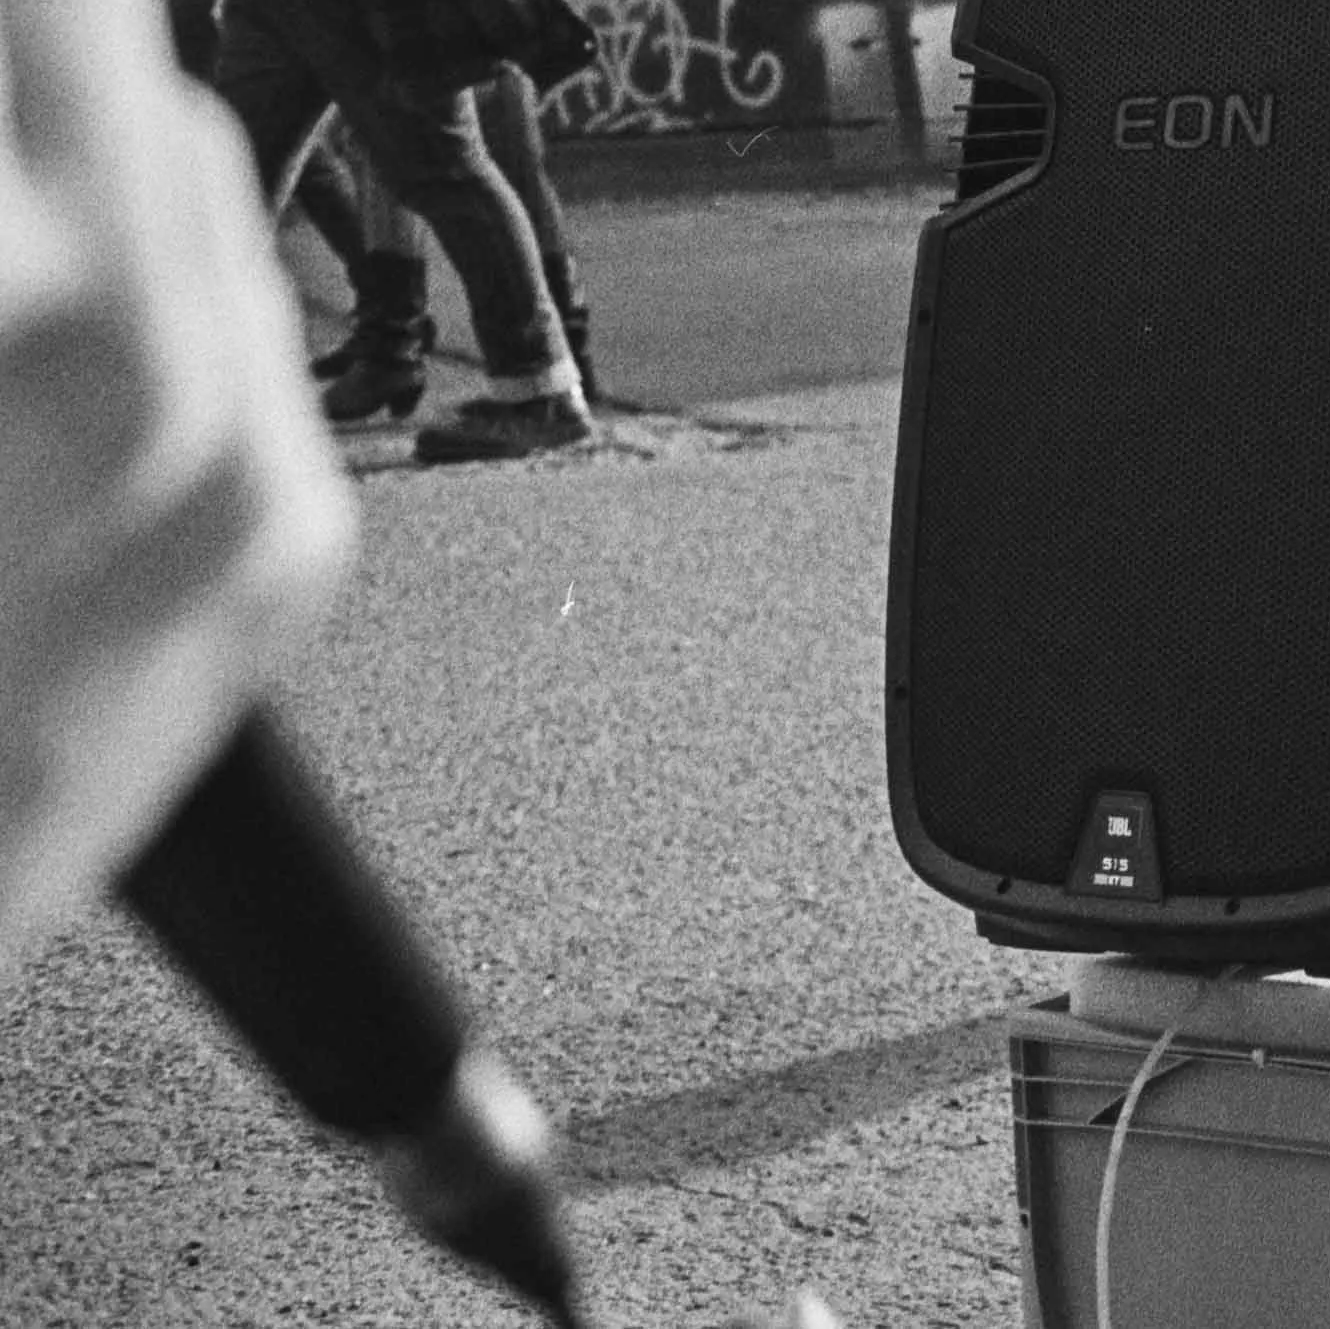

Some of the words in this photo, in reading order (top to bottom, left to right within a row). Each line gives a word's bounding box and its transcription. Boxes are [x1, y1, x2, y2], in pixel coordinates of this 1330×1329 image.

[1115, 93, 1273, 150] EON
[1108, 816, 1132, 837] JBL
[1102, 857, 1128, 872] 515
